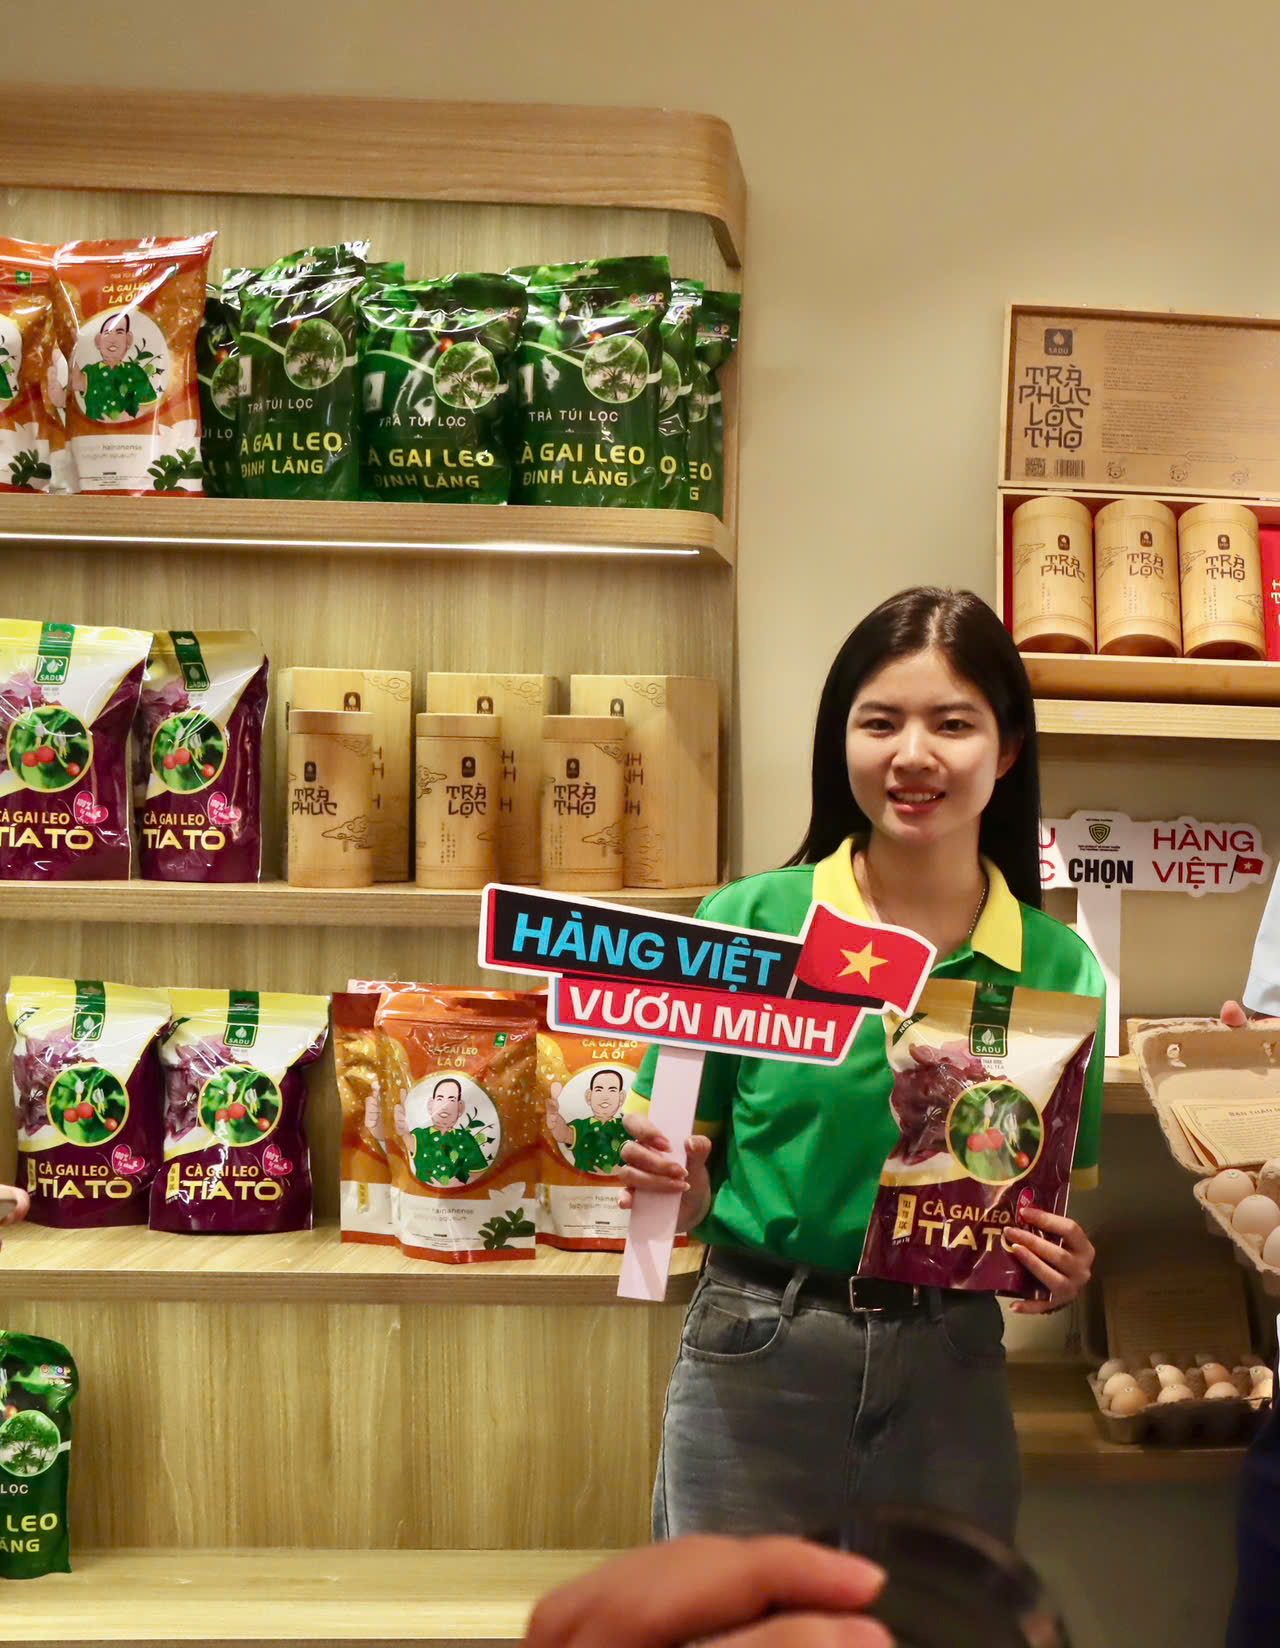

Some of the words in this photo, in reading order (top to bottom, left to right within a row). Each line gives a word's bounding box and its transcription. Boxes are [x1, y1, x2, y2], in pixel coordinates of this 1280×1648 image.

[1025, 364, 1083, 386] TRÀ
[1019, 382, 1091, 406] PHÚC
[288, 398, 313, 412] LỌC
[438, 416, 466, 429] LỌC
[529, 408, 552, 422] TRÀ
[560, 409, 582, 421] TÚI
[589, 411, 619, 425] LỌC
[1029, 402, 1084, 431] LỘC
[240, 433, 249, 456] À
[253, 432, 282, 453] GAI
[293, 432, 342, 452] LEO
[1024, 427, 1083, 453] THỌ
[388, 449, 432, 468] GAI
[443, 449, 495, 468] LEO
[521, 441, 534, 464] À
[540, 443, 583, 463] GAI
[594, 444, 645, 465] LEO
[271, 456, 324, 475] LĂNG
[423, 472, 480, 489] LĂNG
[523, 469, 563, 486] ĐINH
[571, 467, 628, 487] LĂNG
[1045, 553, 1080, 568] TRÀ
[1127, 552, 1164, 567] TRÀ
[1206, 553, 1245, 569] TRÀ
[1040, 564, 1085, 583] PHÚC
[1206, 566, 1245, 583] THỌ
[294, 785, 330, 802] TRÀ
[446, 783, 487, 800] TRÀ
[554, 782, 596, 800] TRÀ
[291, 798, 337, 816] PHÚC
[448, 798, 487, 818] LỘC
[554, 799, 596, 818] THỌ
[13, 811, 38, 824] GAI
[42, 812, 70, 825] LEO
[144, 811, 158, 824] CÀ
[160, 813, 178, 825] GAI
[180, 814, 205, 826] LEO
[0, 823, 43, 849] TÍA
[44, 826, 94, 850] TÔ
[143, 824, 183, 850] TÍA
[183, 826, 226, 850] TÔ
[1153, 824, 1255, 852] HÀNG
[1068, 858, 1134, 889] CHỌN
[1152, 857, 1228, 890] VIỆT
[512, 910, 665, 970] HÀNG
[677, 936, 782, 993] VIỆT
[569, 984, 701, 1036] VƯƠN
[712, 1002, 838, 1053] MÌNH
[899, 1018, 914, 1034] NEW
[228, 1037, 250, 1046] SADU
[617, 1040, 638, 1049] LEO
[976, 1046, 1001, 1054] SADU
[461, 1047, 478, 1056] LEO
[39, 1161, 53, 1175] CÀ
[56, 1164, 79, 1176] GAI
[82, 1165, 109, 1177] LEO
[185, 1163, 203, 1177] CÀ
[206, 1164, 229, 1177] GAI
[232, 1165, 259, 1177] LEO
[37, 1175, 85, 1199] TÍA
[85, 1176, 133, 1199] TÔ
[182, 1176, 233, 1200] TÍA
[234, 1177, 281, 1200] TÔ
[922, 1199, 945, 1217] CÀ
[949, 1204, 980, 1222] GAI
[982, 1208, 1011, 1225] LEO
[918, 1218, 978, 1251] TÍA
[0, 1483, 29, 1496] LỌC
[7, 1512, 58, 1533] LEO
